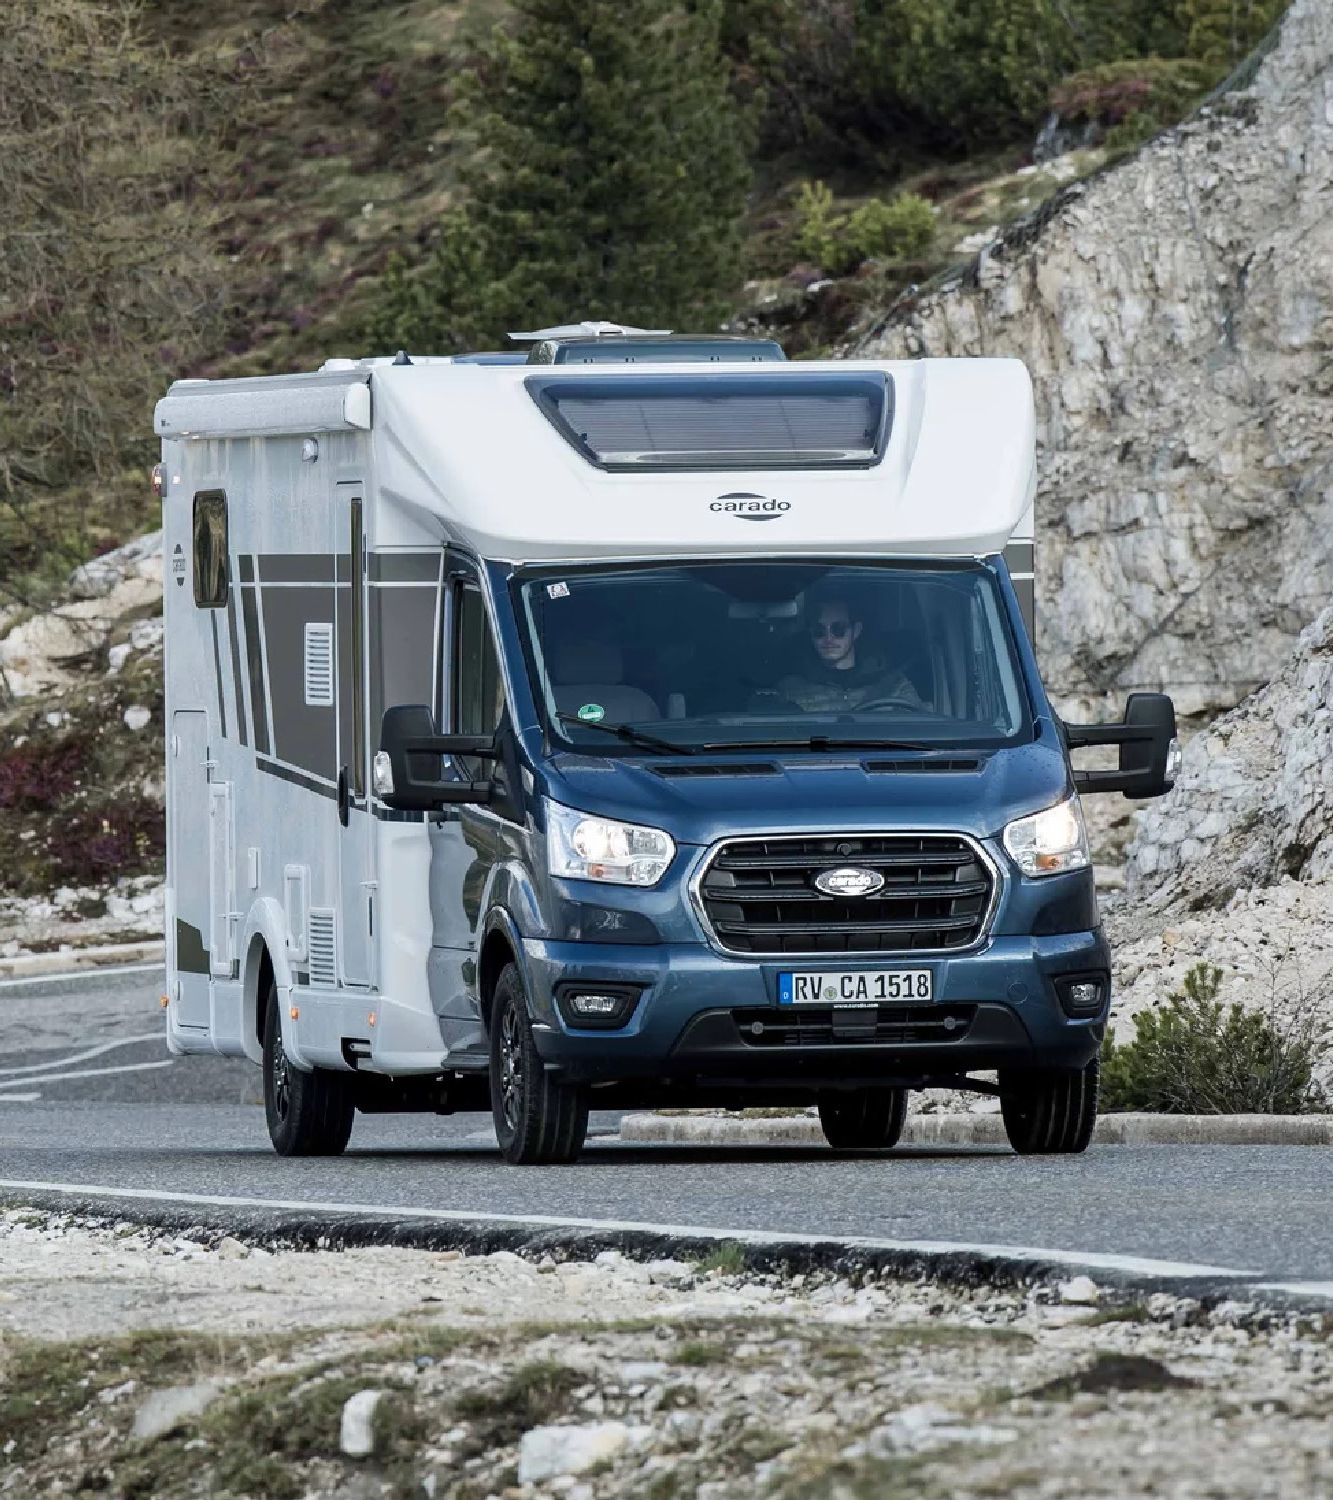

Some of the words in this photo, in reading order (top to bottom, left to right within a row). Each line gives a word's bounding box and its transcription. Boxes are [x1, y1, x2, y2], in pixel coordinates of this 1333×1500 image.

[709, 499, 792, 512] carado
[795, 976, 823, 1001] RV
[840, 974, 868, 1000] CA
[874, 973, 930, 998] 1518
